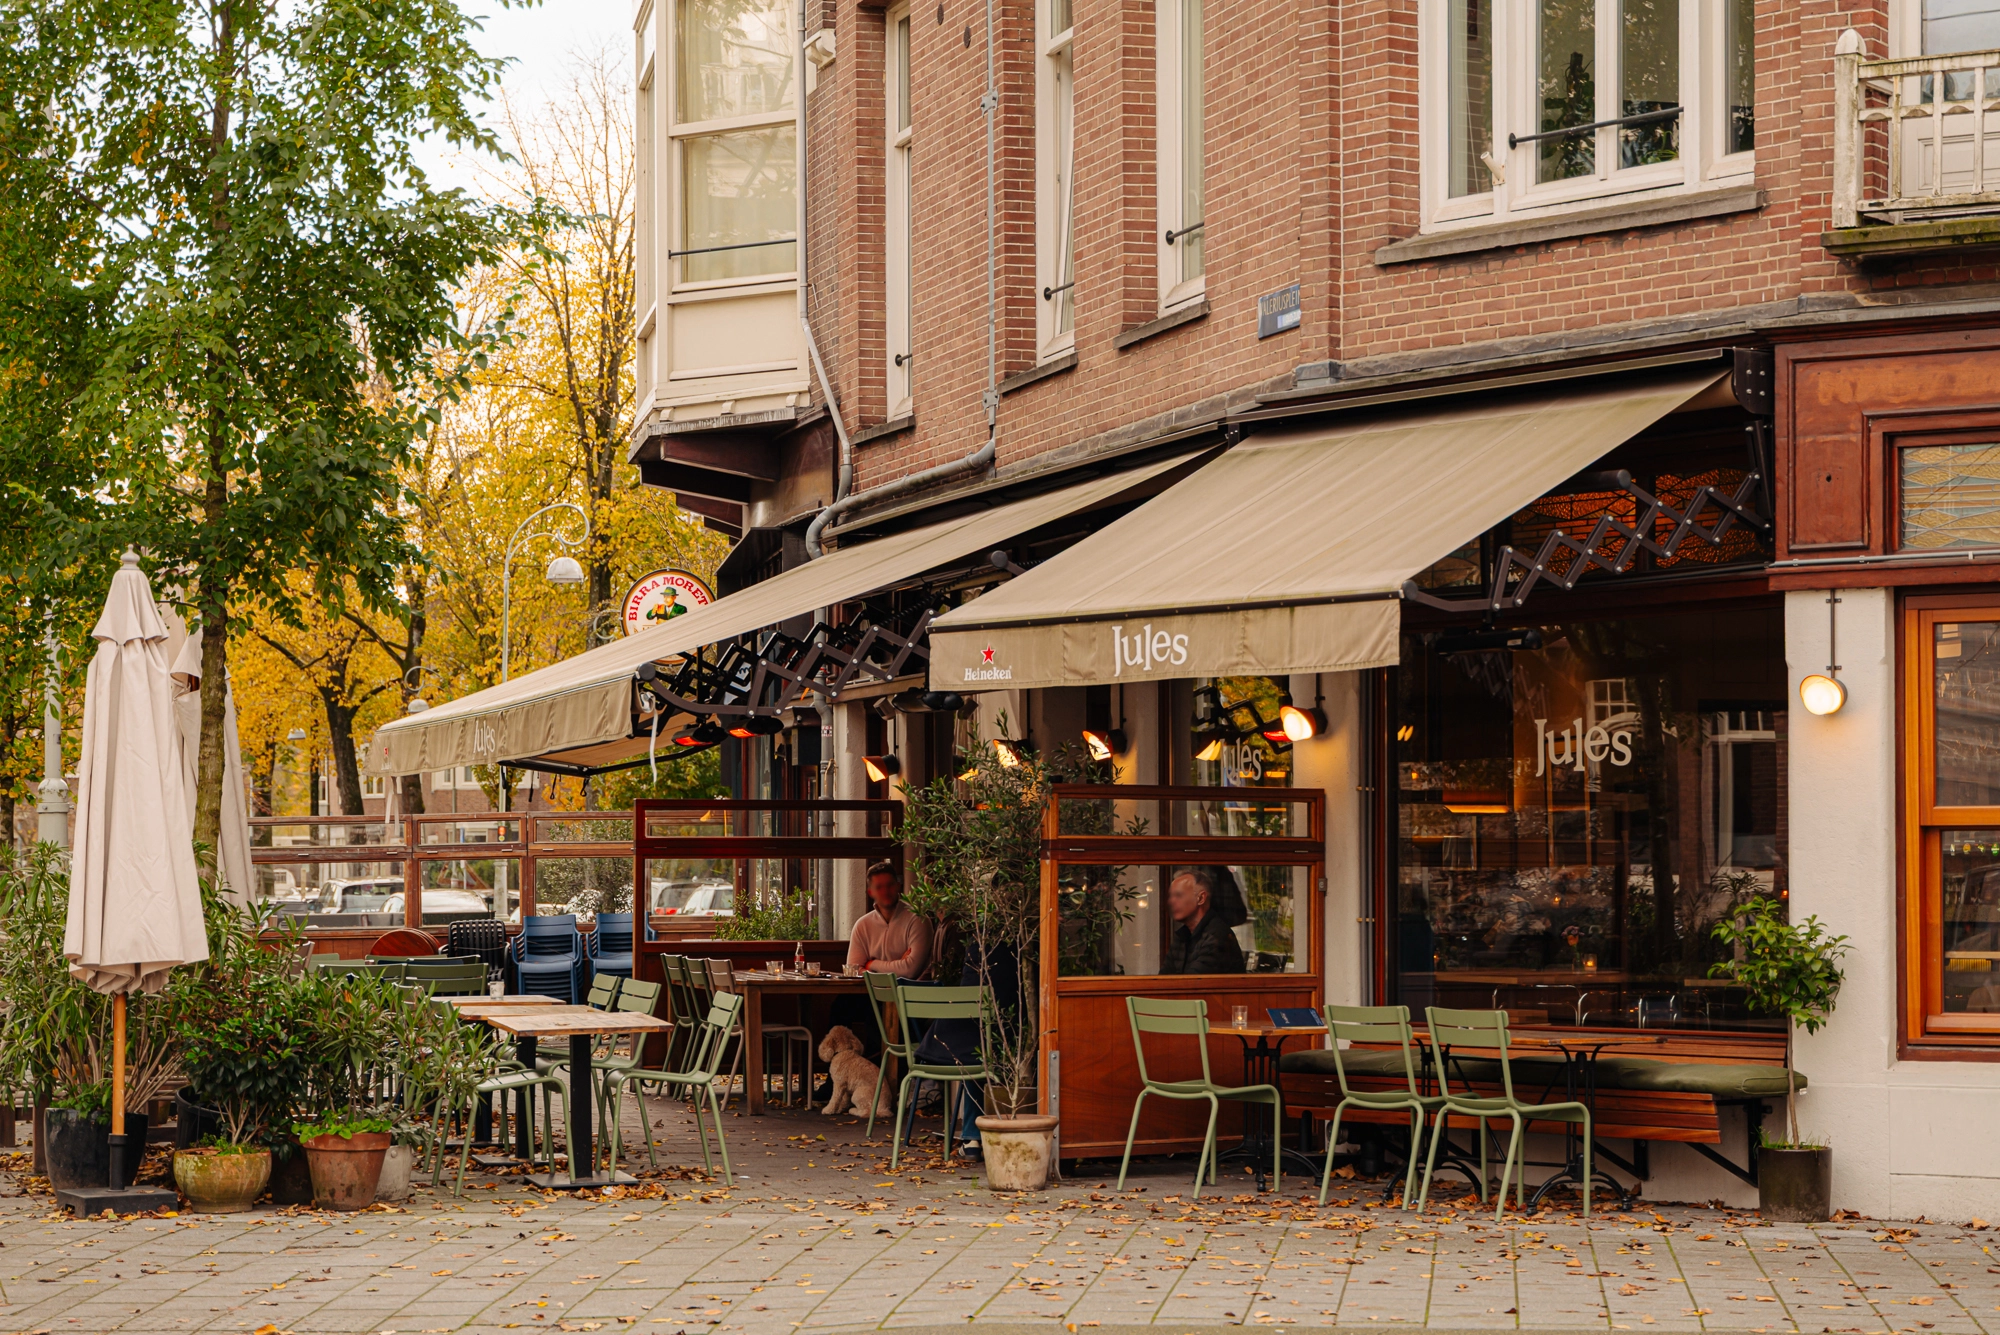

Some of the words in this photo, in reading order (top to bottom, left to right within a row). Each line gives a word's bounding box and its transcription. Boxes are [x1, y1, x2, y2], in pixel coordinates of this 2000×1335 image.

[628, 580, 660, 621] BIRRA
[662, 576, 708, 606] MORET
[964, 665, 1012, 681] Heineken
[1112, 624, 1188, 677] Jules
[472, 720, 495, 760] Jules
[1534, 717, 1632, 777] Jules
